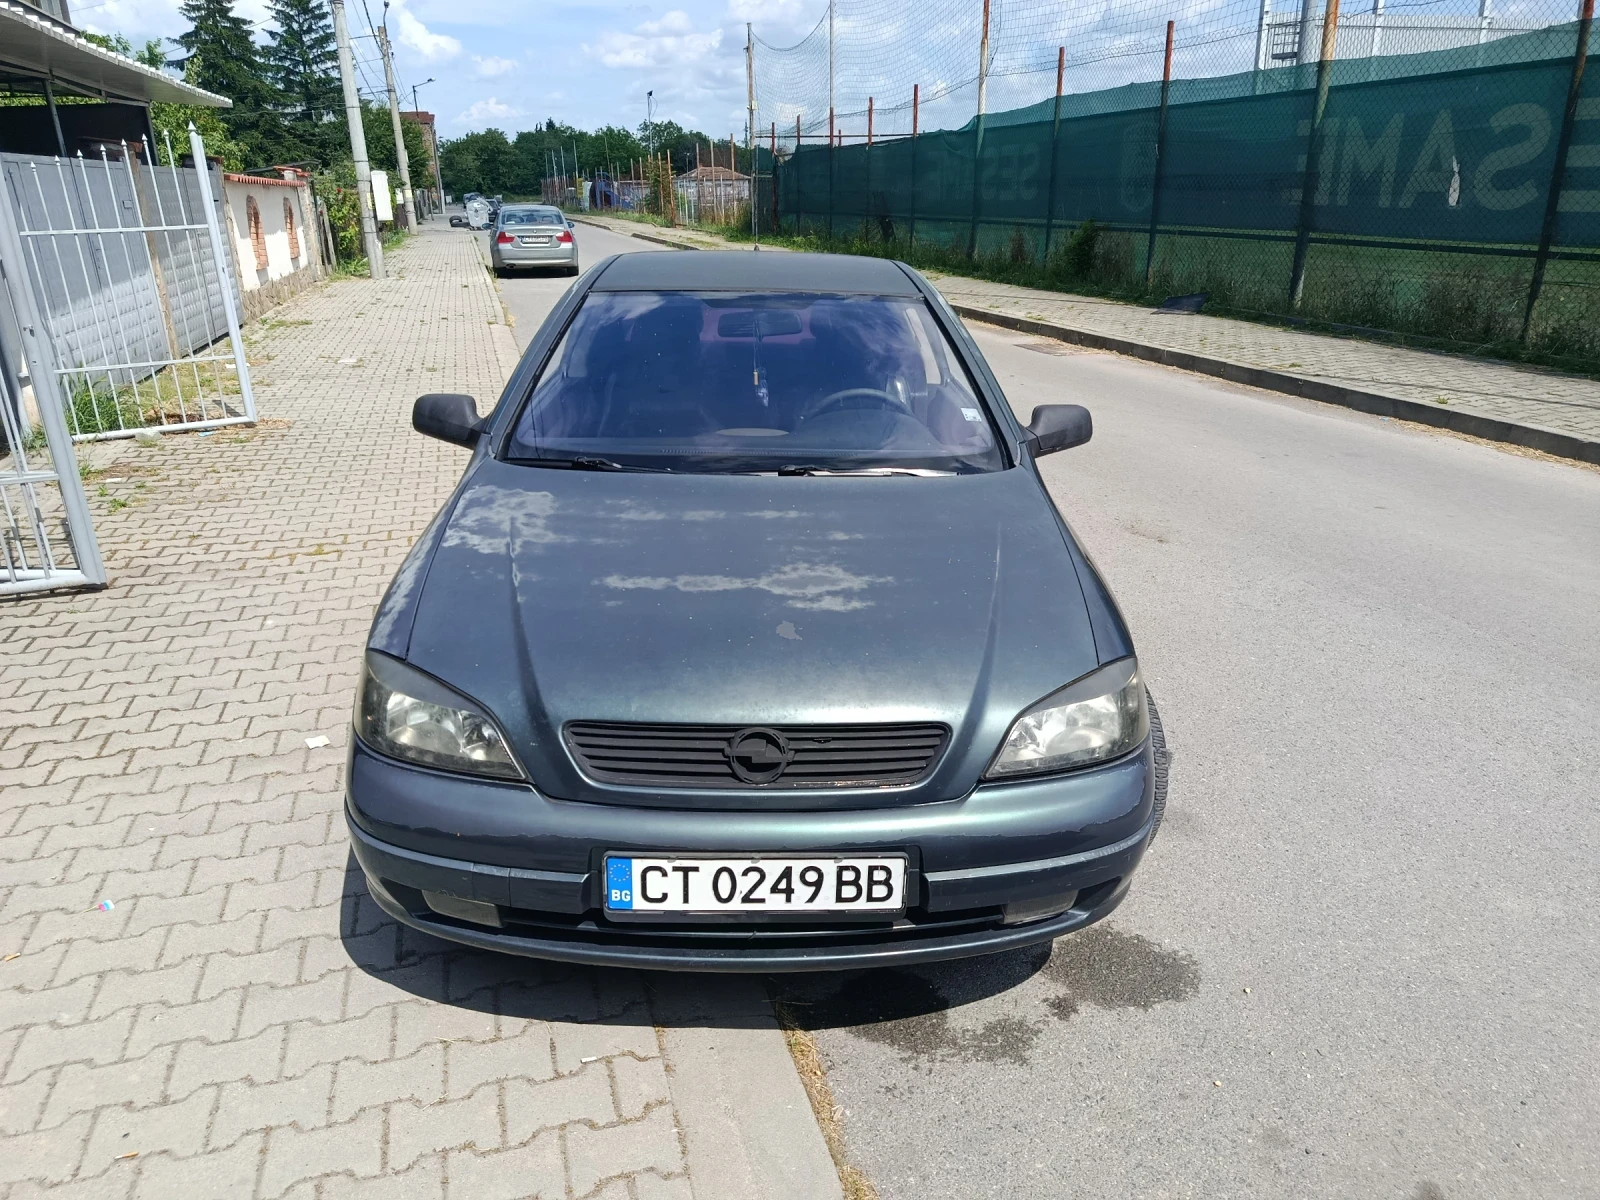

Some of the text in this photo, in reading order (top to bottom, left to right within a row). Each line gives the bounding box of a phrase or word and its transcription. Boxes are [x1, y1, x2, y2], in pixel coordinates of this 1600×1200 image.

[611, 889, 631, 902] BG
[640, 865, 894, 904] CT 0249 BB
